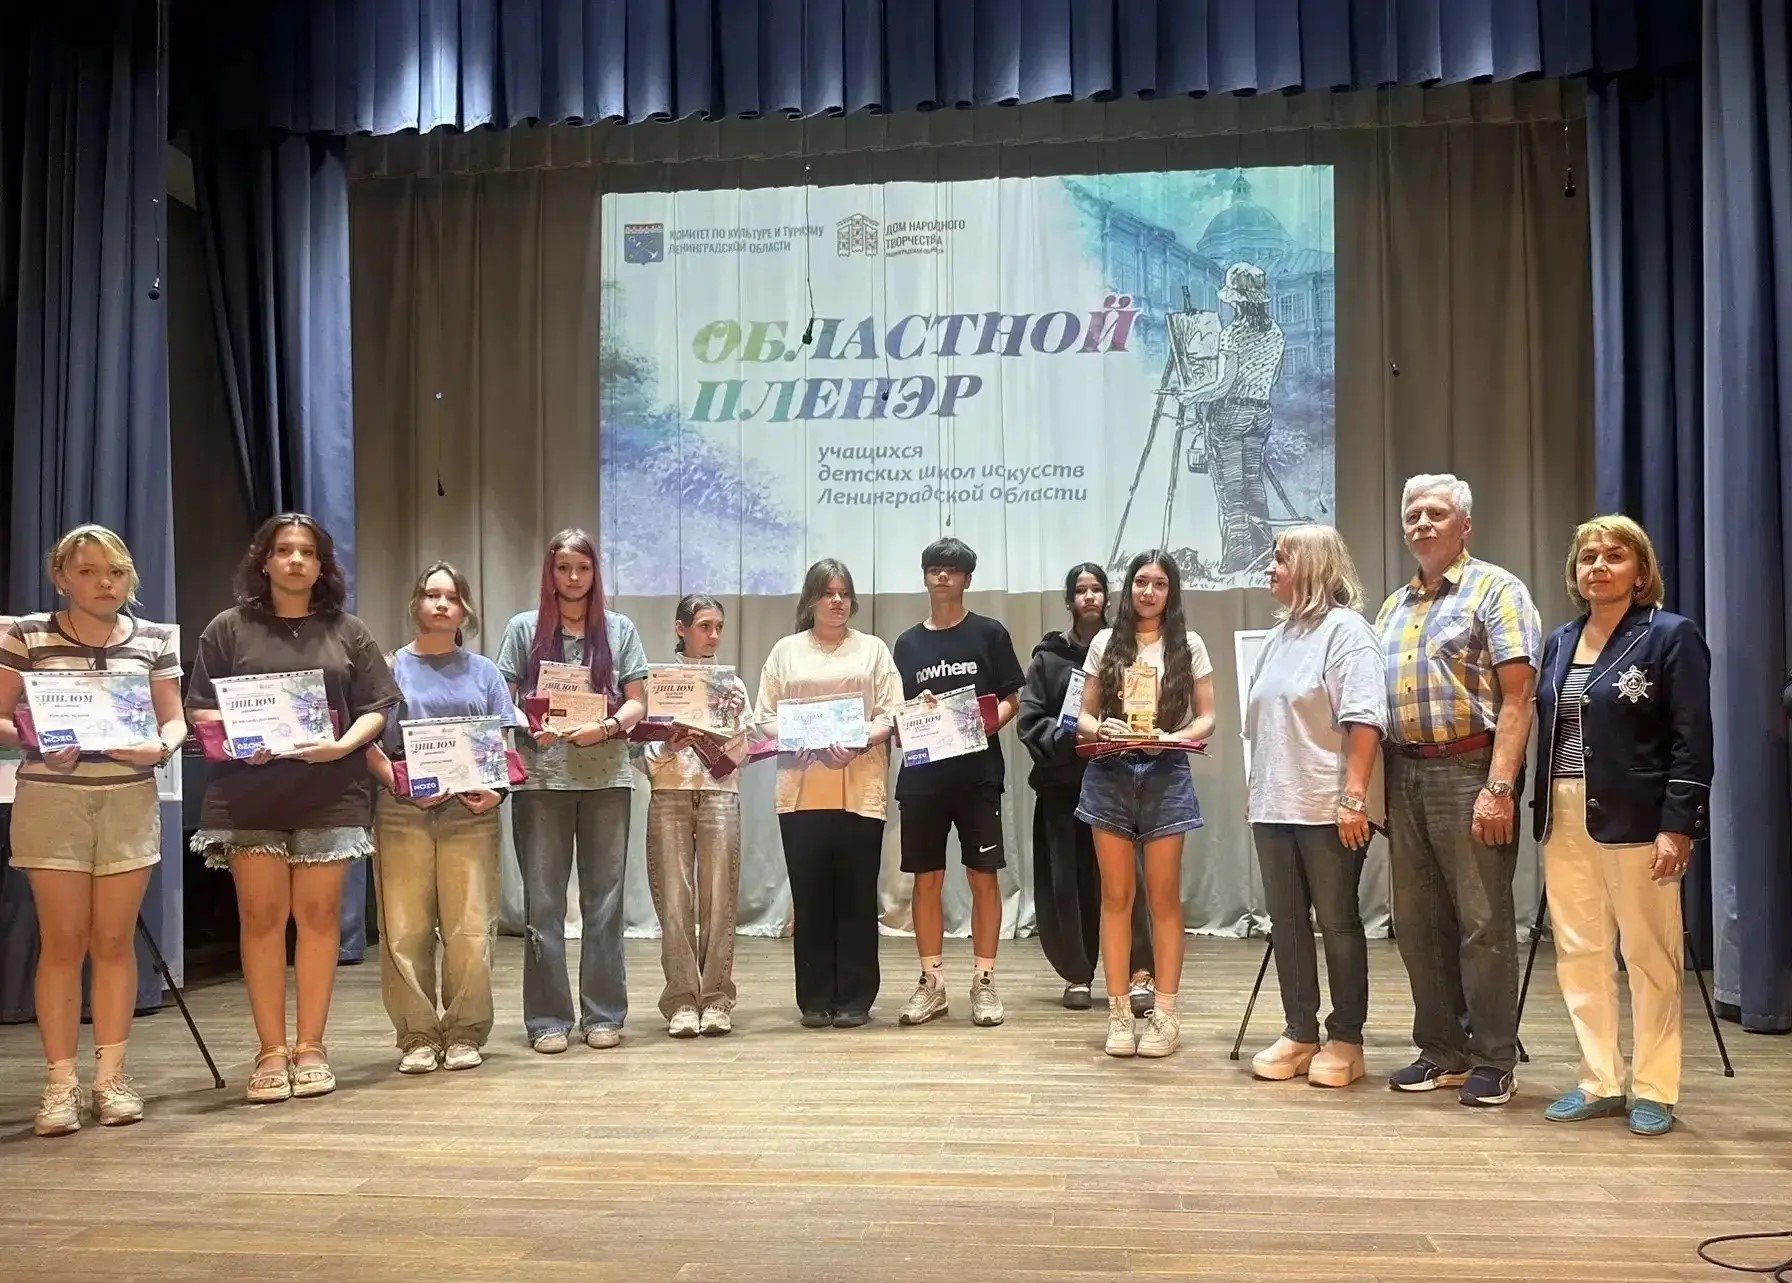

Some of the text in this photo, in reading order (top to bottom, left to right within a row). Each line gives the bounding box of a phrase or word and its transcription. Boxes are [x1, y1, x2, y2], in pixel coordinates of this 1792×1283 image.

[670, 225, 824, 241] КОМИТЕТ ПО КУЛЬТУРЕ И ТУРИЗМУ
[886, 219, 966, 236] ДОМ НАРОДНОГО
[668, 240, 791, 254] ЛЕНИНГРАДСКОЙ ОБЛАСТИ
[886, 234, 943, 249] ТВОРЧЕСТВА
[692, 293, 1140, 363] ОБЛАСТНОЙ
[687, 374, 983, 423] ПЛЕНЭР
[818, 445, 924, 464] учащихся
[818, 463, 1085, 484] детских школ искусств
[817, 484, 1088, 508] Ленинградской области
[916, 659, 977, 685] nowhere
